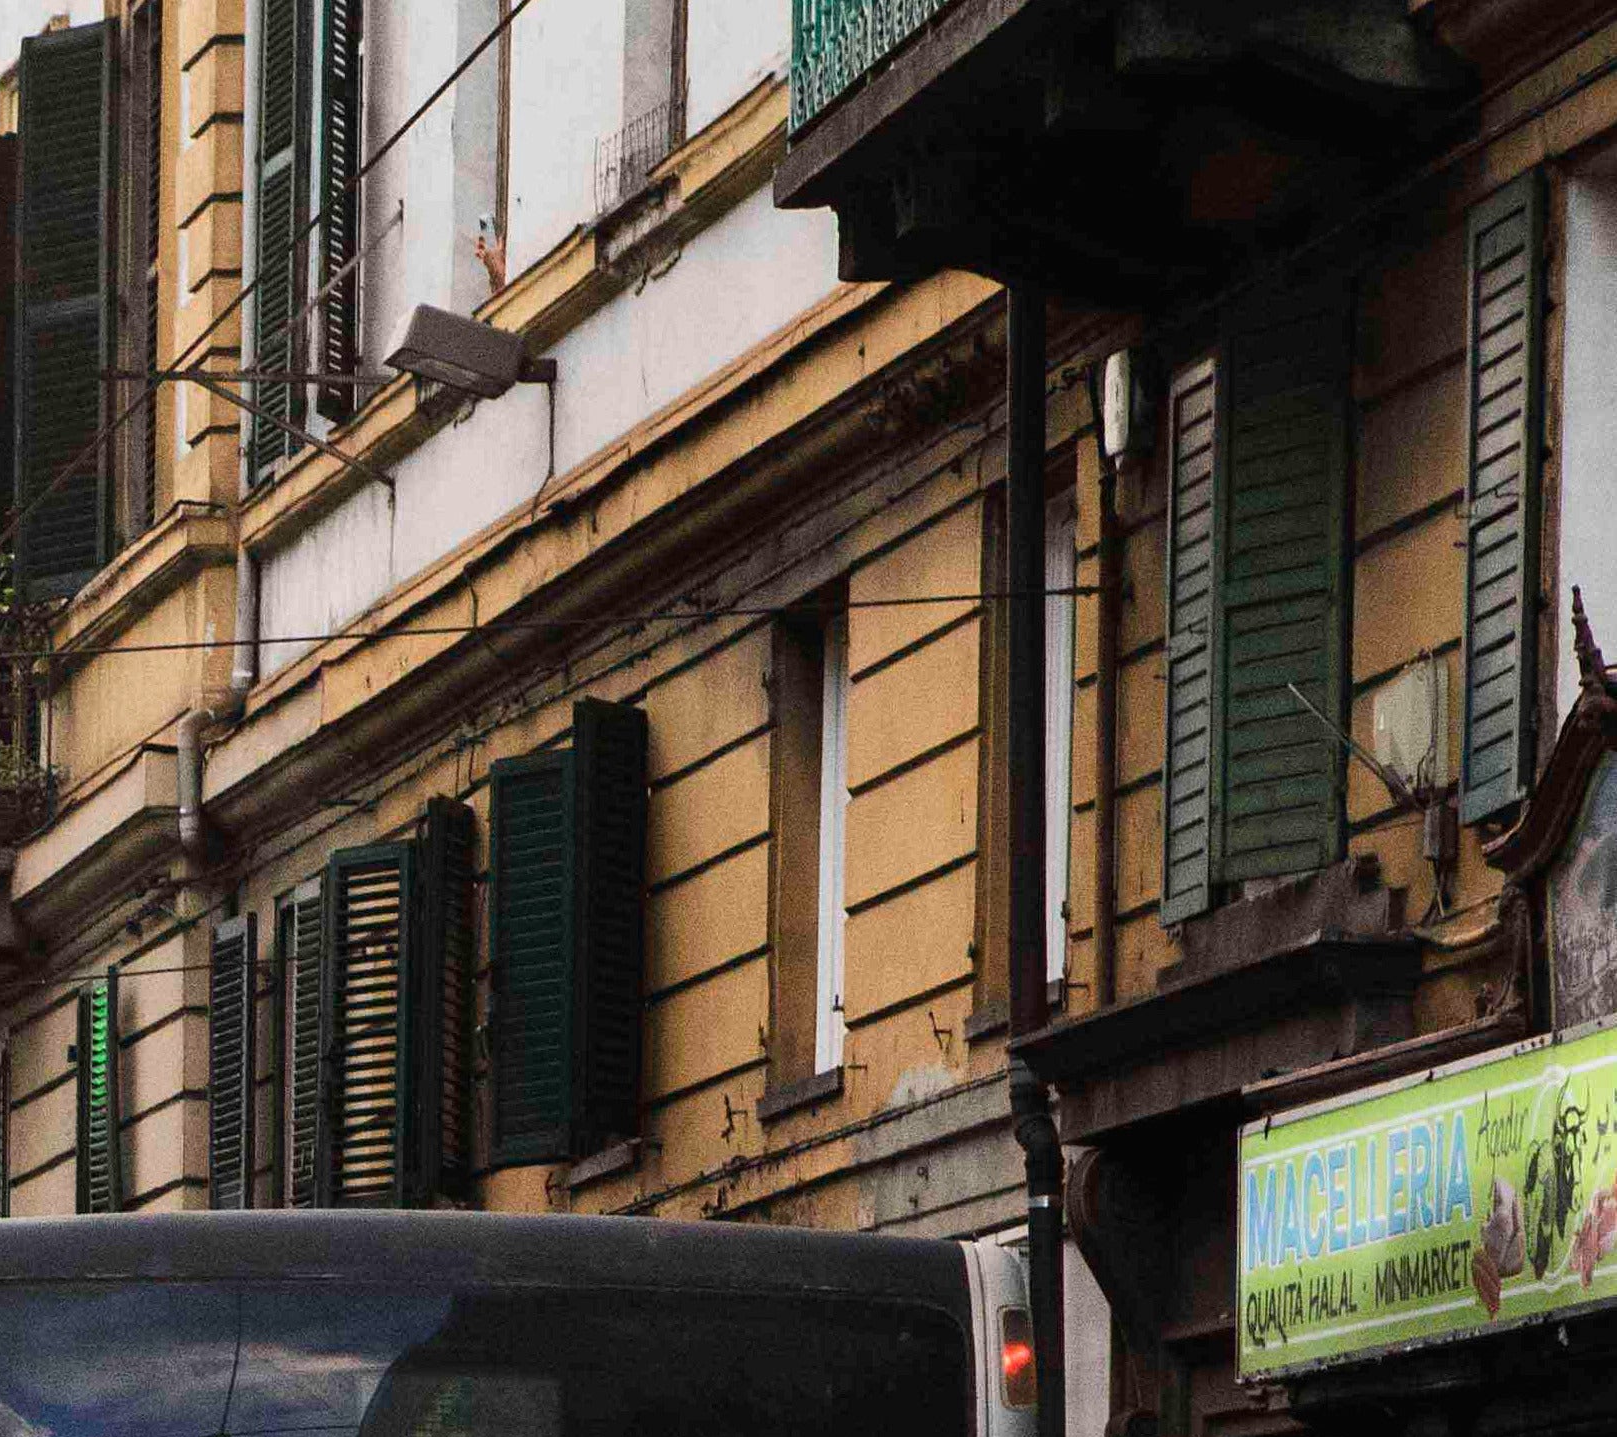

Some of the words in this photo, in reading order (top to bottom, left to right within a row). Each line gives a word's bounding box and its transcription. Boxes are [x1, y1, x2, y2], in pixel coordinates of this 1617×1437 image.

[1244, 1112, 1474, 1275] MACELLERIA
[1309, 1269, 1357, 1323] HALAL
[1375, 1241, 1472, 1309] MINIMARKET
